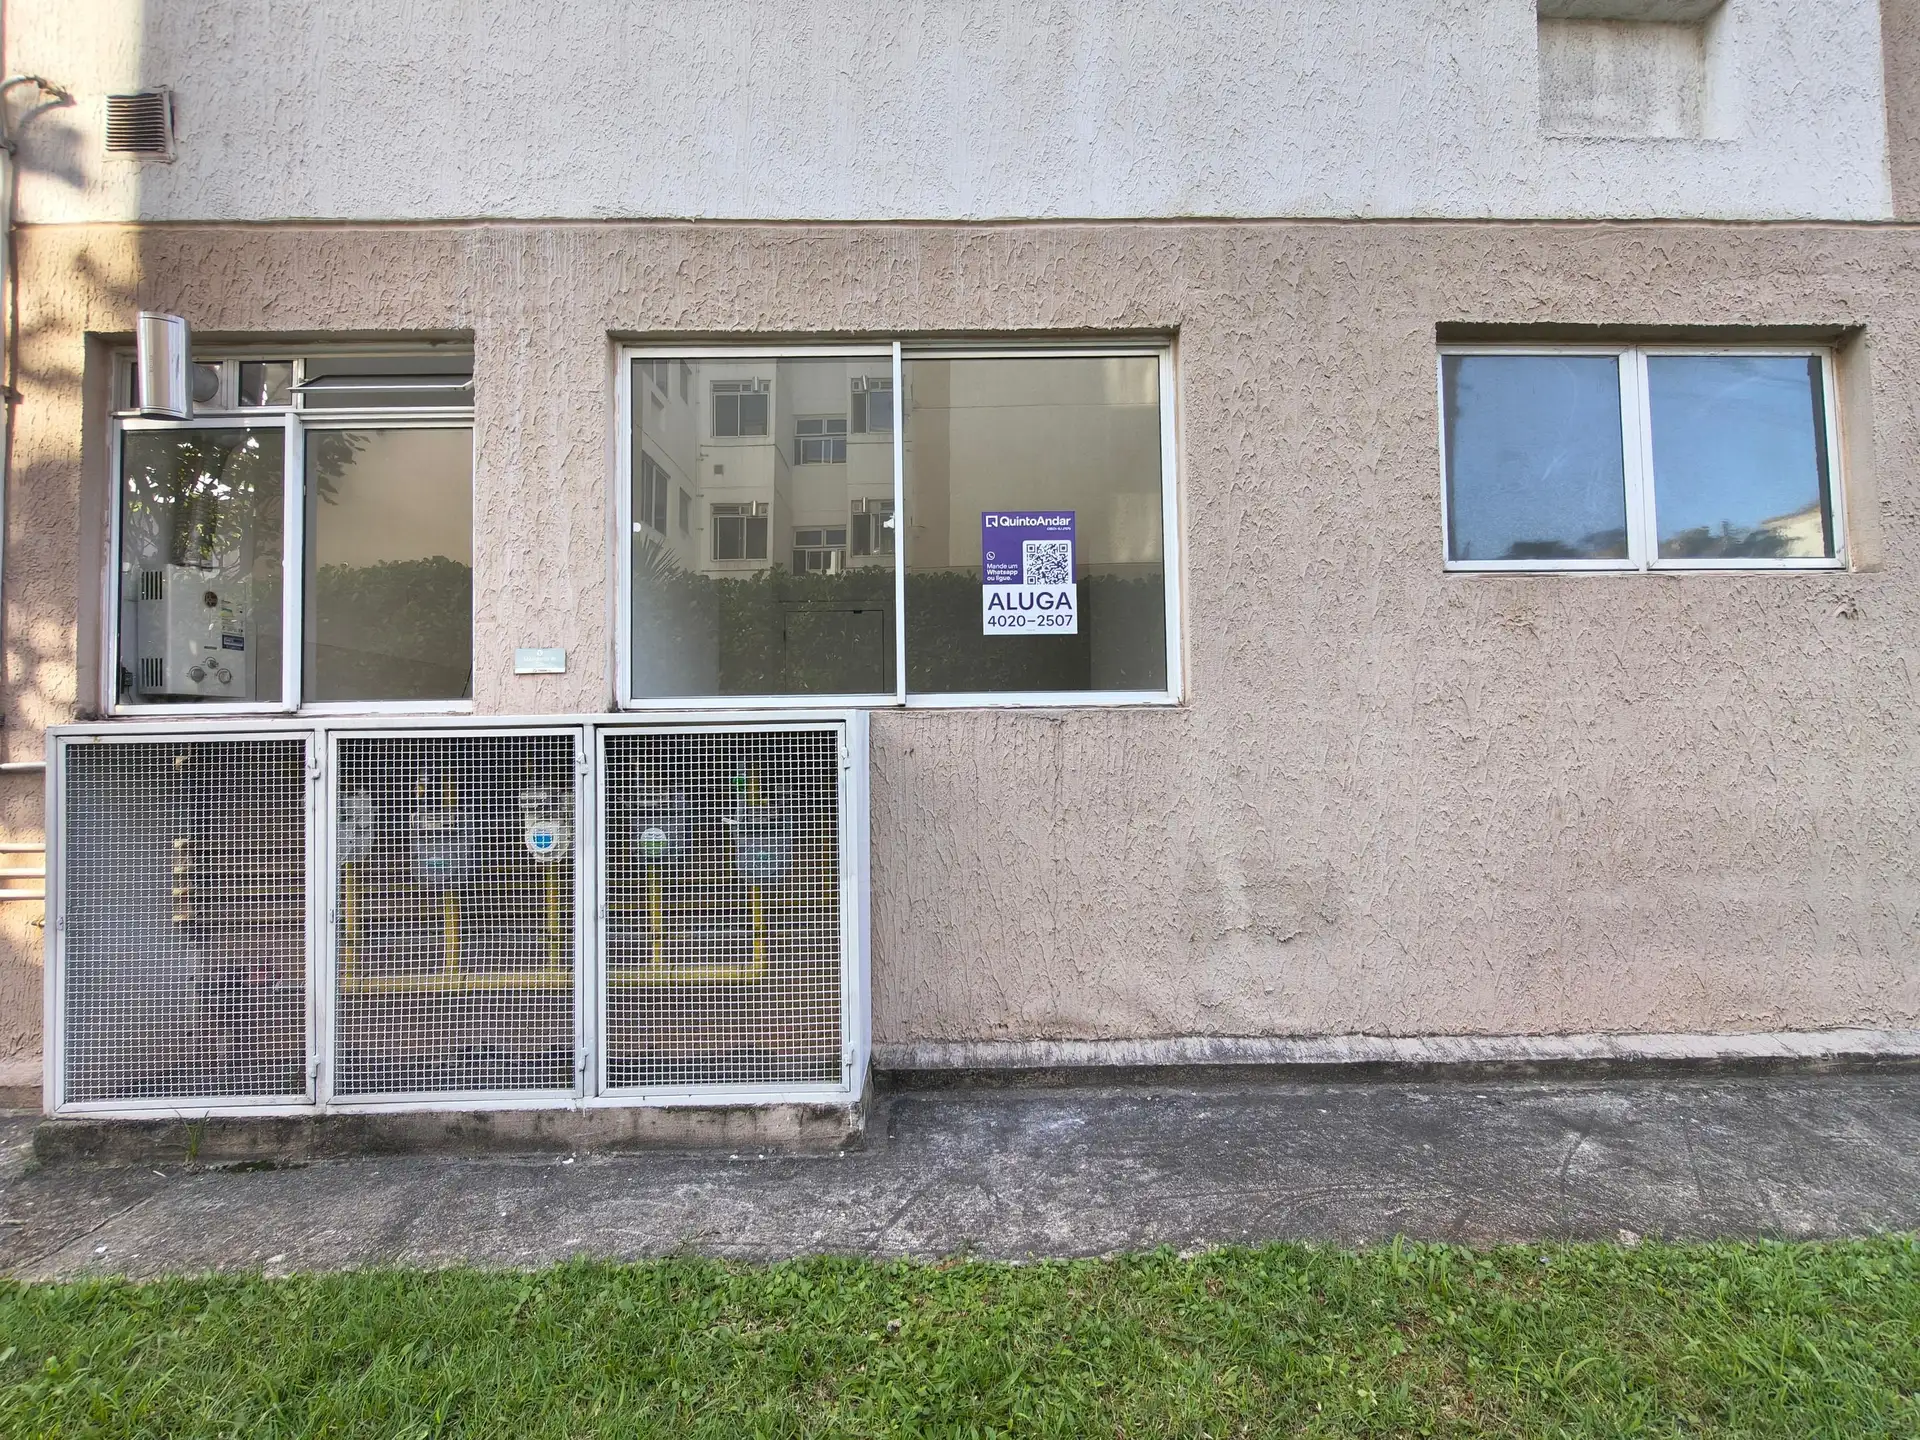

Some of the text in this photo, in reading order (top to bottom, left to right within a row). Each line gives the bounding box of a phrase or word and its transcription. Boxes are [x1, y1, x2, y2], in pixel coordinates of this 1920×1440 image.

[1000, 516, 1071, 527] QuintoAndar
[988, 592, 1072, 610] ALUGA
[988, 615, 1073, 627] 4020-2507
